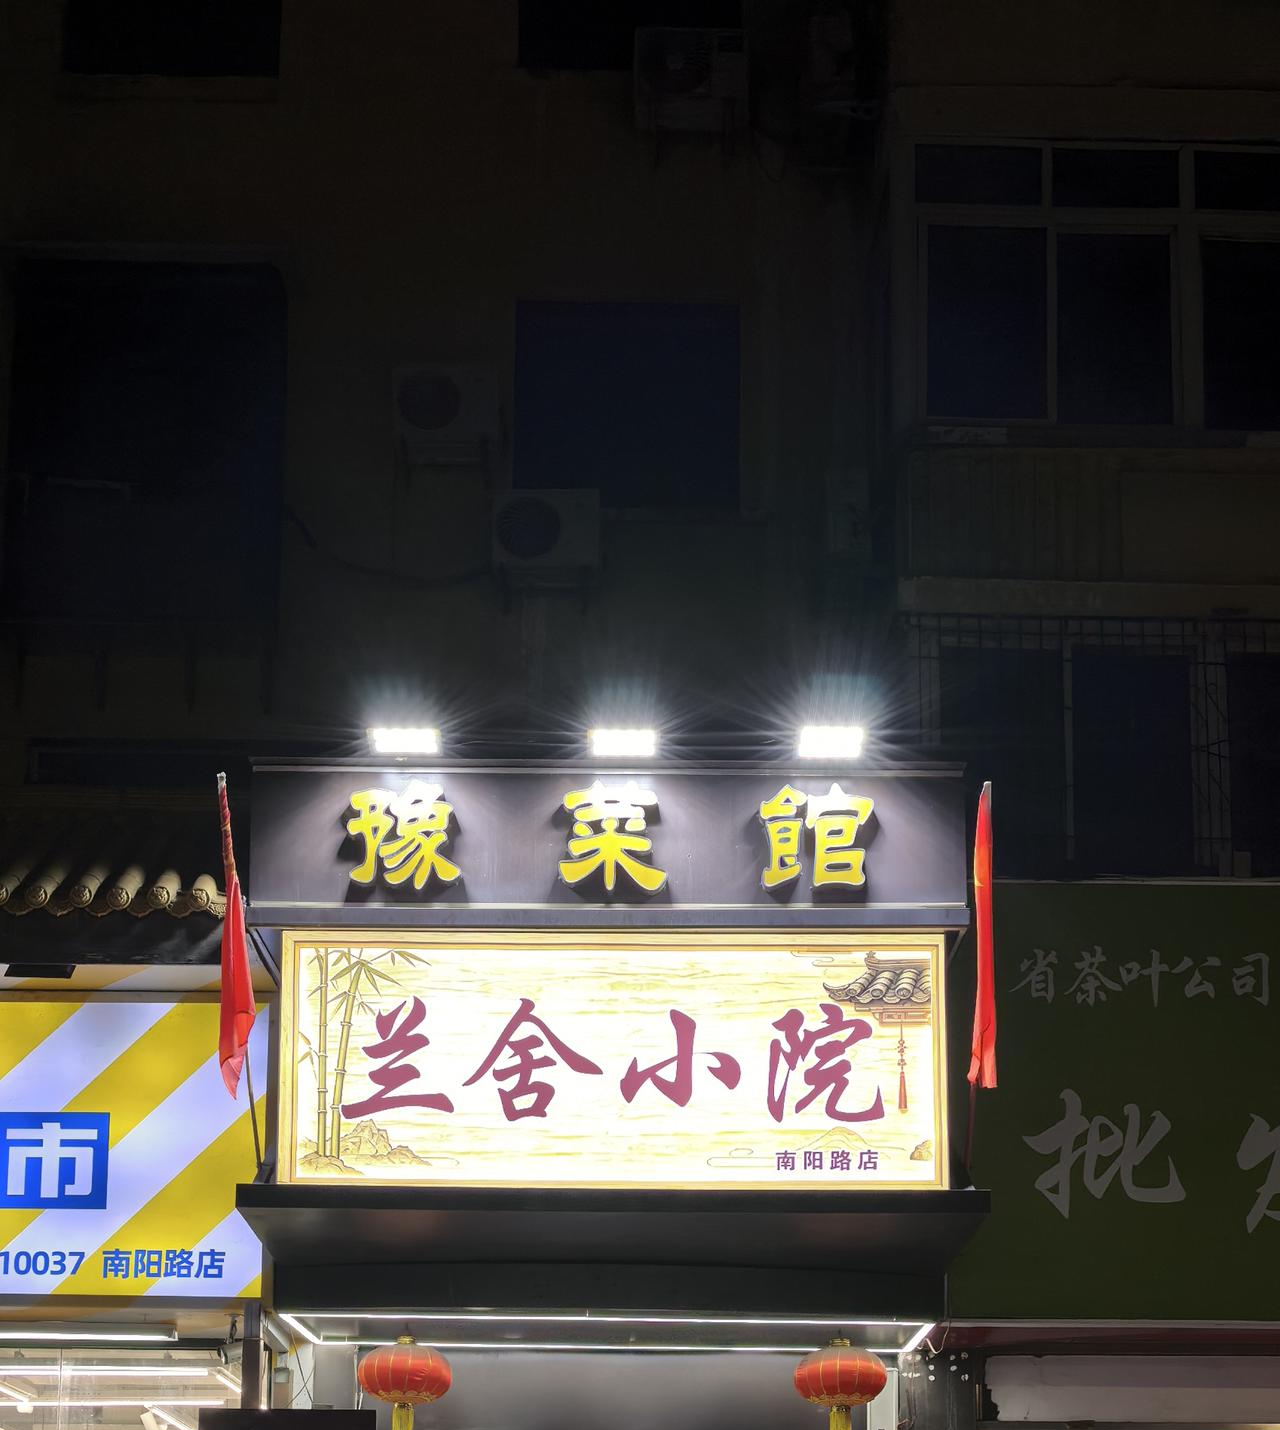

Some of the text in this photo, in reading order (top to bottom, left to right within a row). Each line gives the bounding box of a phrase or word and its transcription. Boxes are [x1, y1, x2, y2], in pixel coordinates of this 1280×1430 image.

[346, 779, 876, 892] 豫菜館
[1009, 945, 1270, 1008] 省茶叶公司
[340, 995, 885, 1124] 兰舍小院
[6, 1121, 98, 1199] 市
[775, 1148, 880, 1172] 南阳路店
[102, 1248, 226, 1280] 南阳路店
